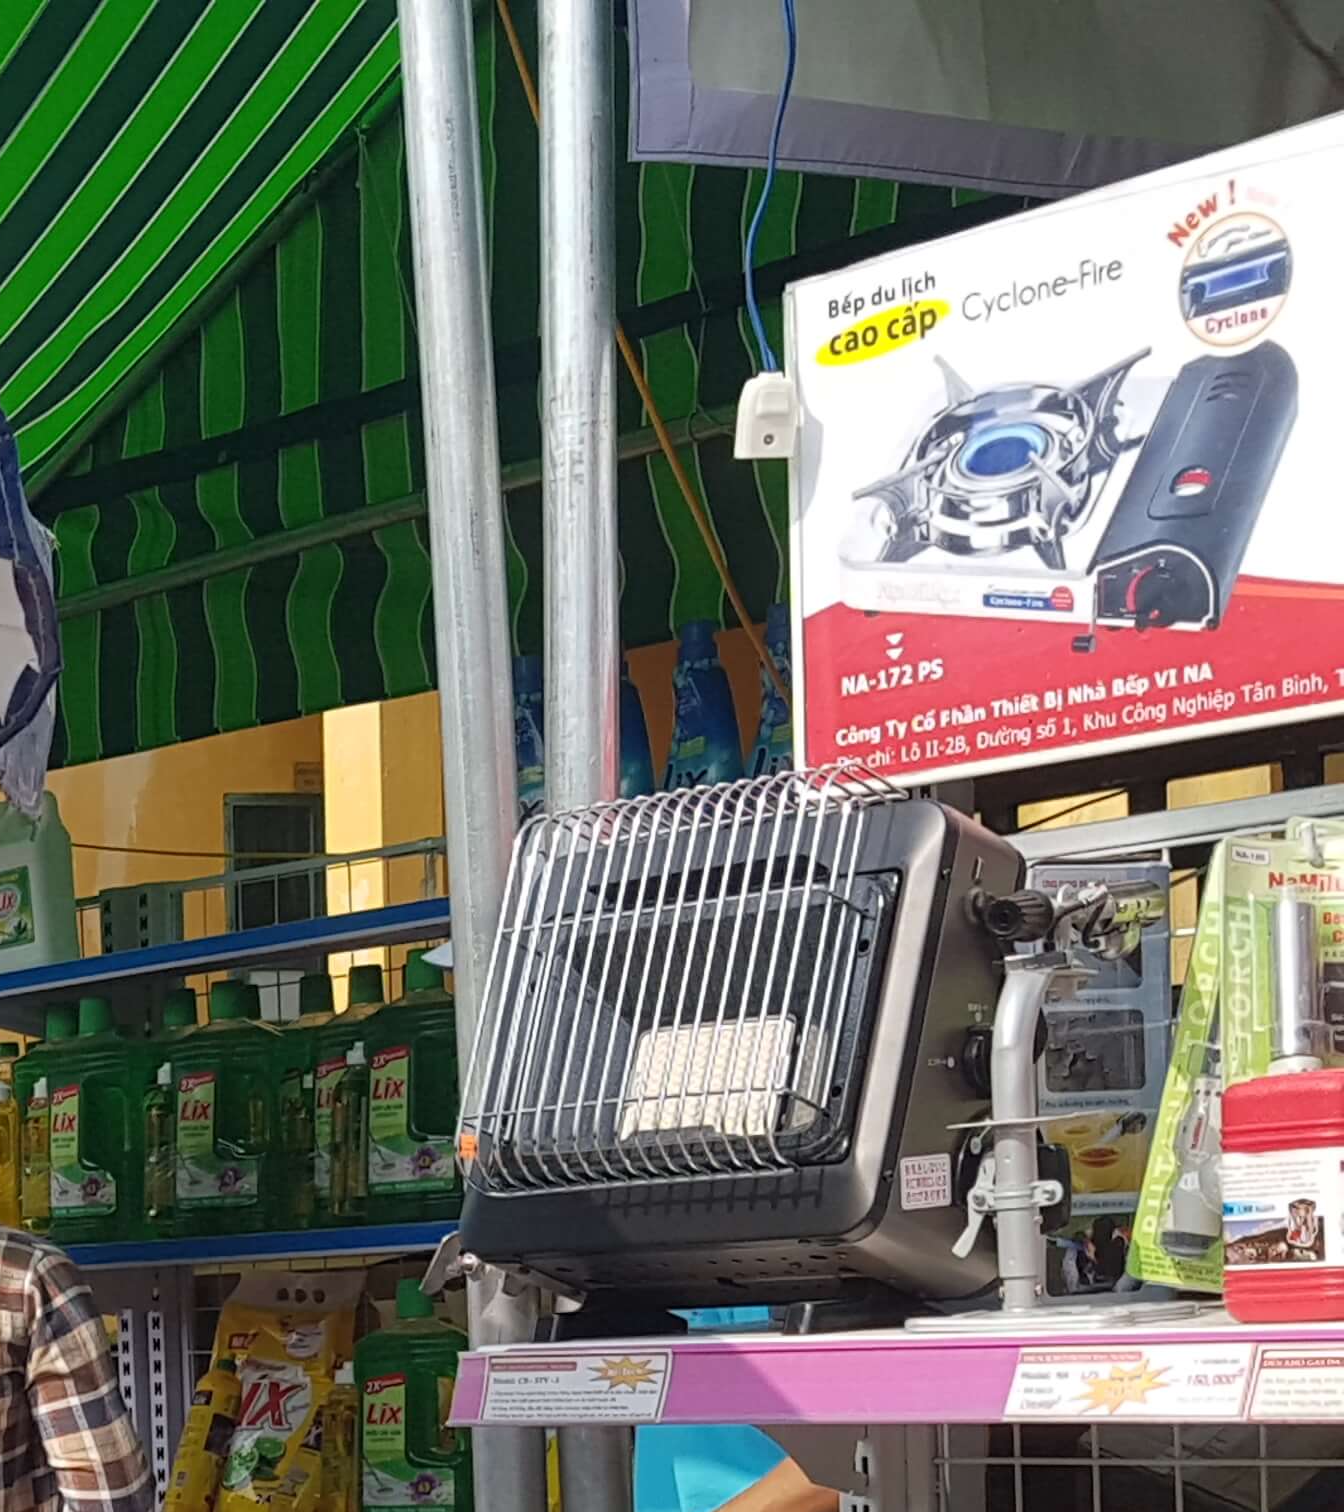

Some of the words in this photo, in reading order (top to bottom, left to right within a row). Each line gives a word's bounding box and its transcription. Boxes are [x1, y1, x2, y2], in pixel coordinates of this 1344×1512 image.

[1167, 192, 1218, 248] New
[827, 288, 866, 320] Bếp
[871, 280, 897, 308] du
[962, 257, 1123, 323] Cyclone-Fire
[828, 325, 879, 358] cao
[887, 302, 939, 352] cấp
[835, 724, 881, 747] Công
[885, 719, 907, 742] Ty
[991, 693, 1039, 717] Thiết
[1068, 680, 1107, 704] Nhà
[1112, 673, 1149, 702] Bếp
[1155, 666, 1179, 687] VI
[1183, 662, 1214, 684] NA
[841, 669, 912, 697] NA-172
[918, 659, 944, 681] PS
[901, 739, 921, 763] Lô
[976, 718, 1032, 750] Đường
[1036, 712, 1057, 739] số
[1083, 708, 1118, 730] Khu
[1122, 700, 1167, 725] Công
[1173, 687, 1236, 718] Nghiệp
[1240, 677, 1276, 702] Tân
[1282, 670, 1328, 699] Bình,
